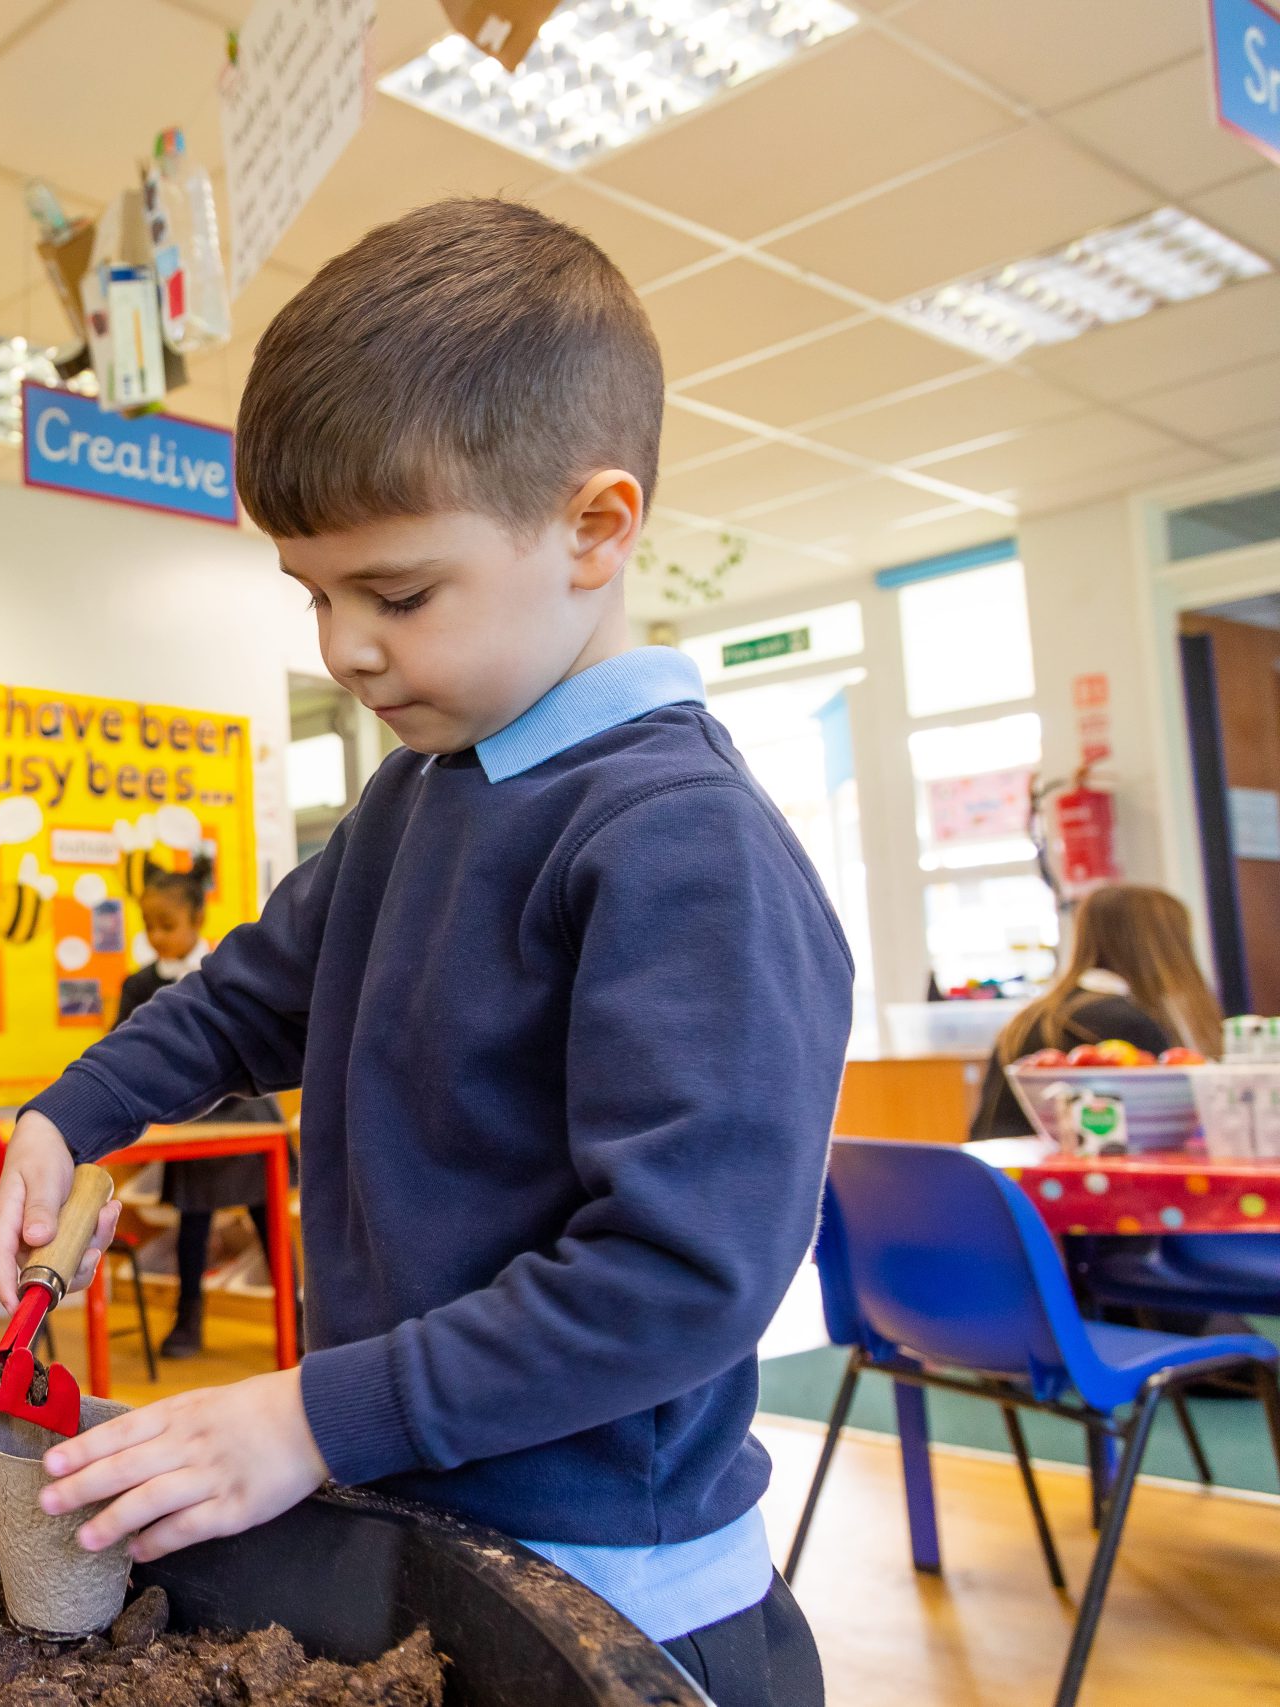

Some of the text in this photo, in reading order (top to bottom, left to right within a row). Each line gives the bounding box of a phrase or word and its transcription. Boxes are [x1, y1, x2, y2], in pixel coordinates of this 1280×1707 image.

[35, 406, 230, 499] Creative
[4, 685, 124, 743] have
[86, 752, 234, 804] bees...
